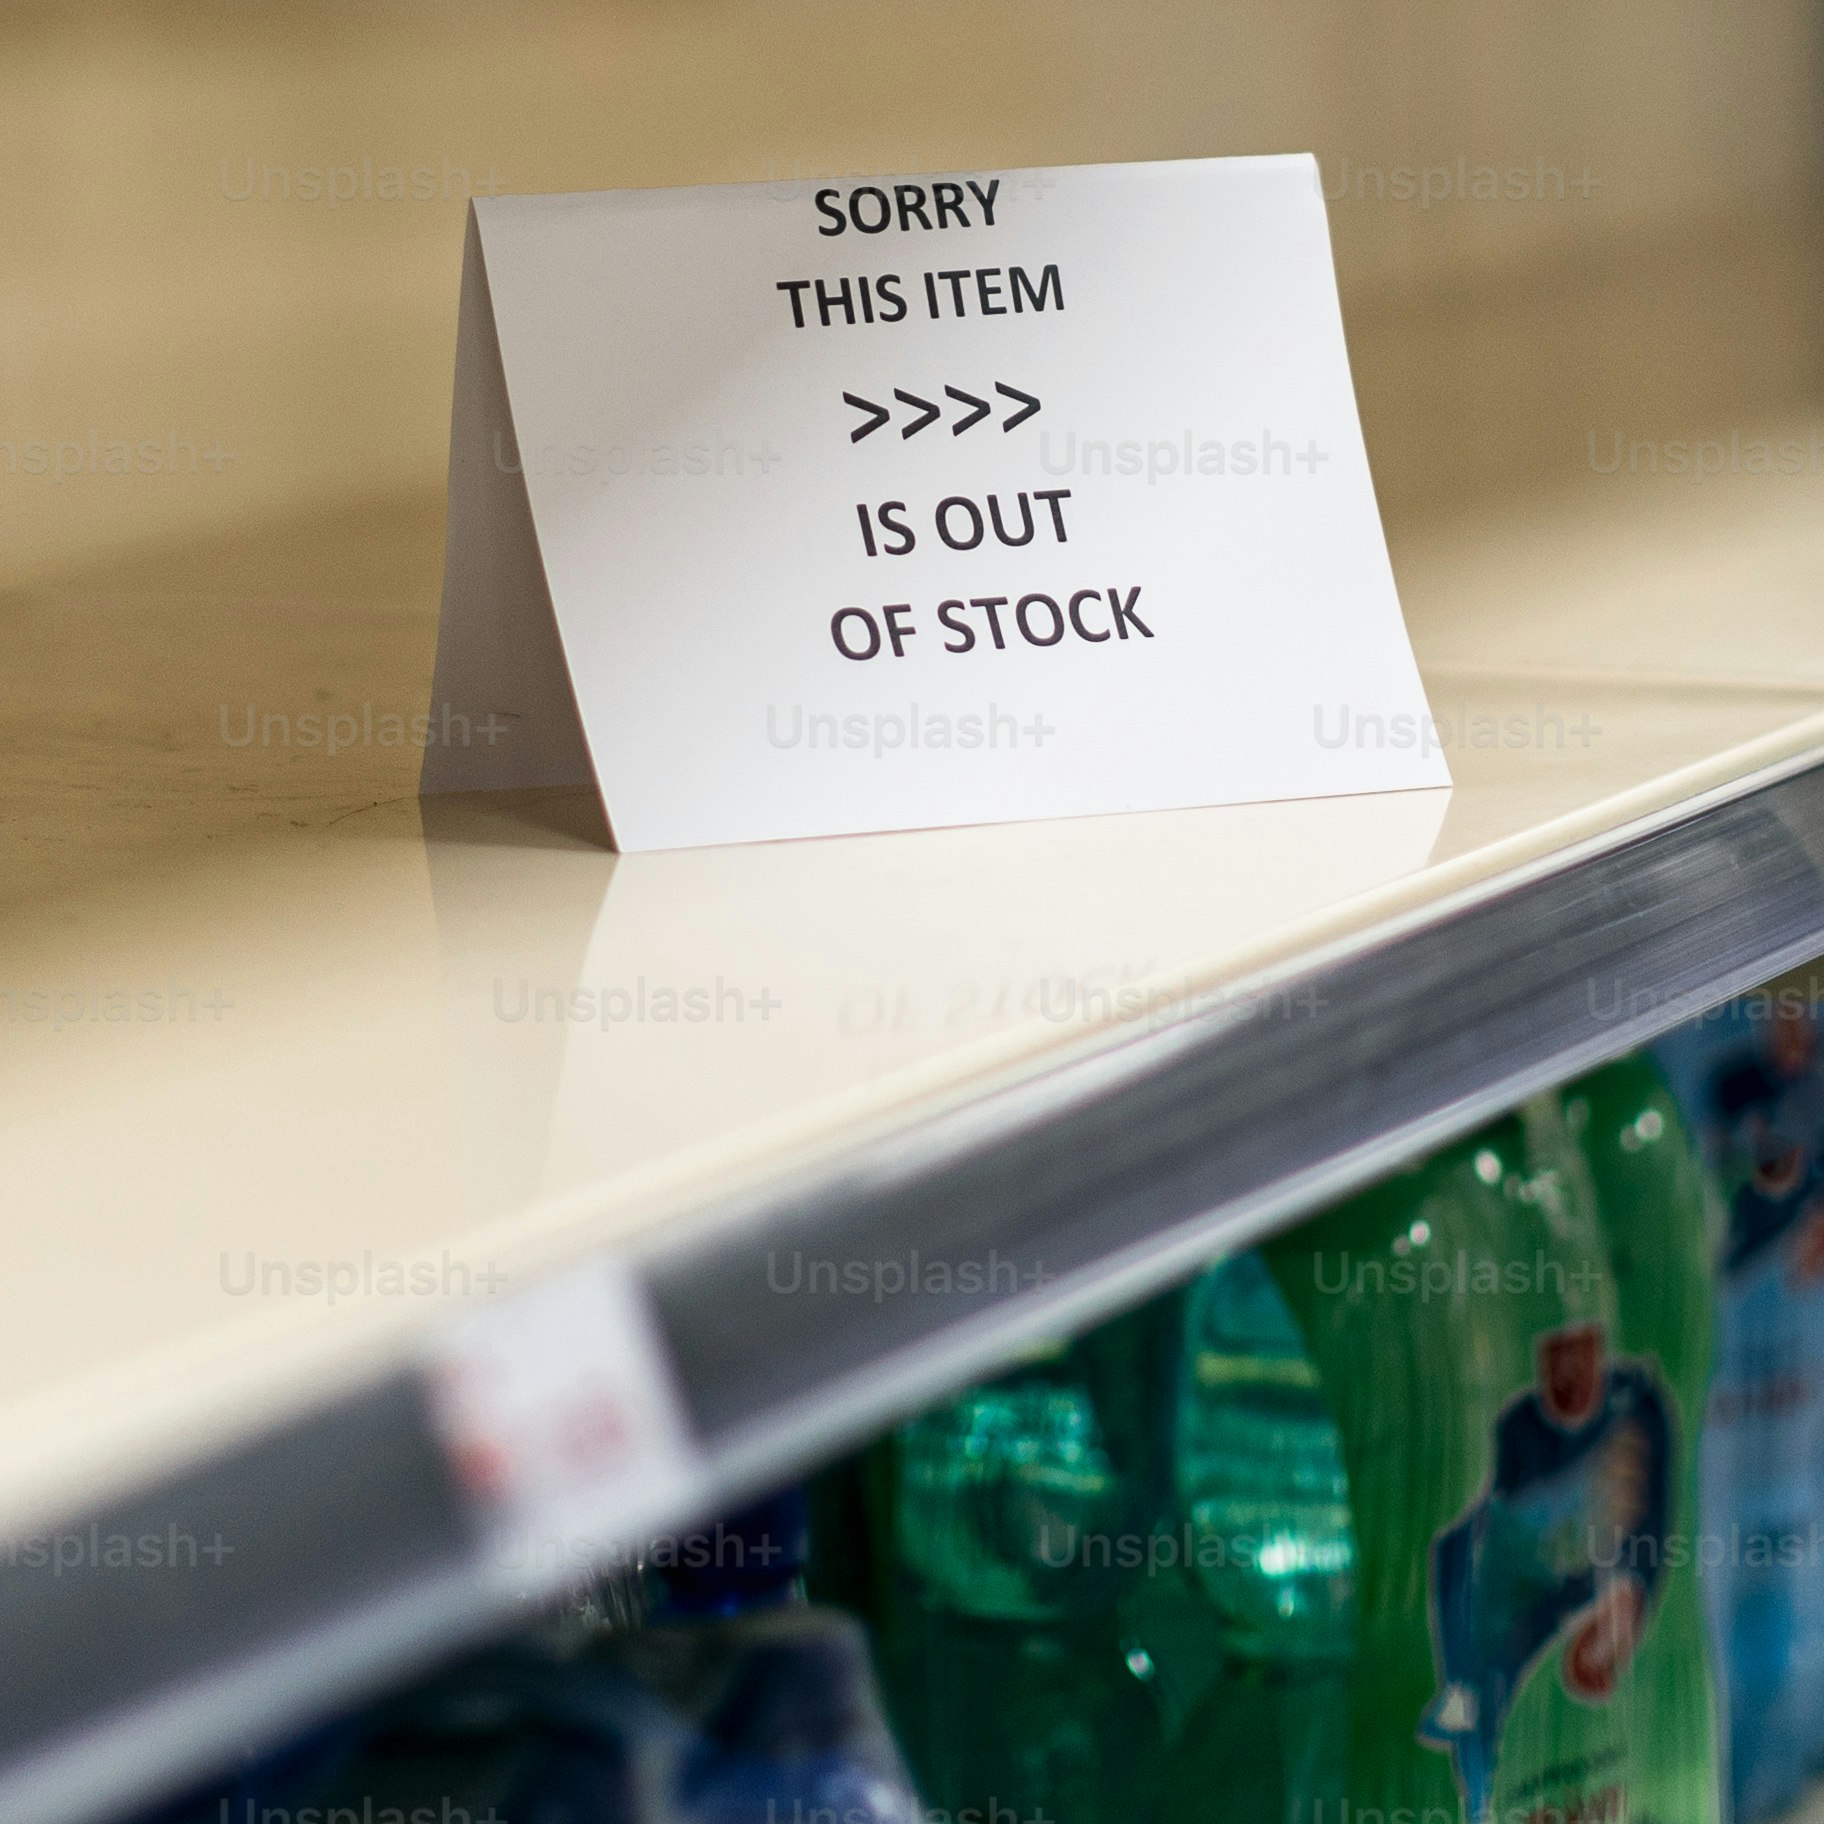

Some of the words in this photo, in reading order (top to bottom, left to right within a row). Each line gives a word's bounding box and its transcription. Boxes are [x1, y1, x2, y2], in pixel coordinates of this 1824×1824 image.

[814, 179, 1000, 237] SORRY
[775, 274, 908, 329] THIS
[923, 264, 1065, 320] ITEM
[856, 501, 916, 557] IS
[935, 489, 1072, 551] OUT
[831, 604, 916, 661] OF
[937, 586, 1155, 654] STOCK
